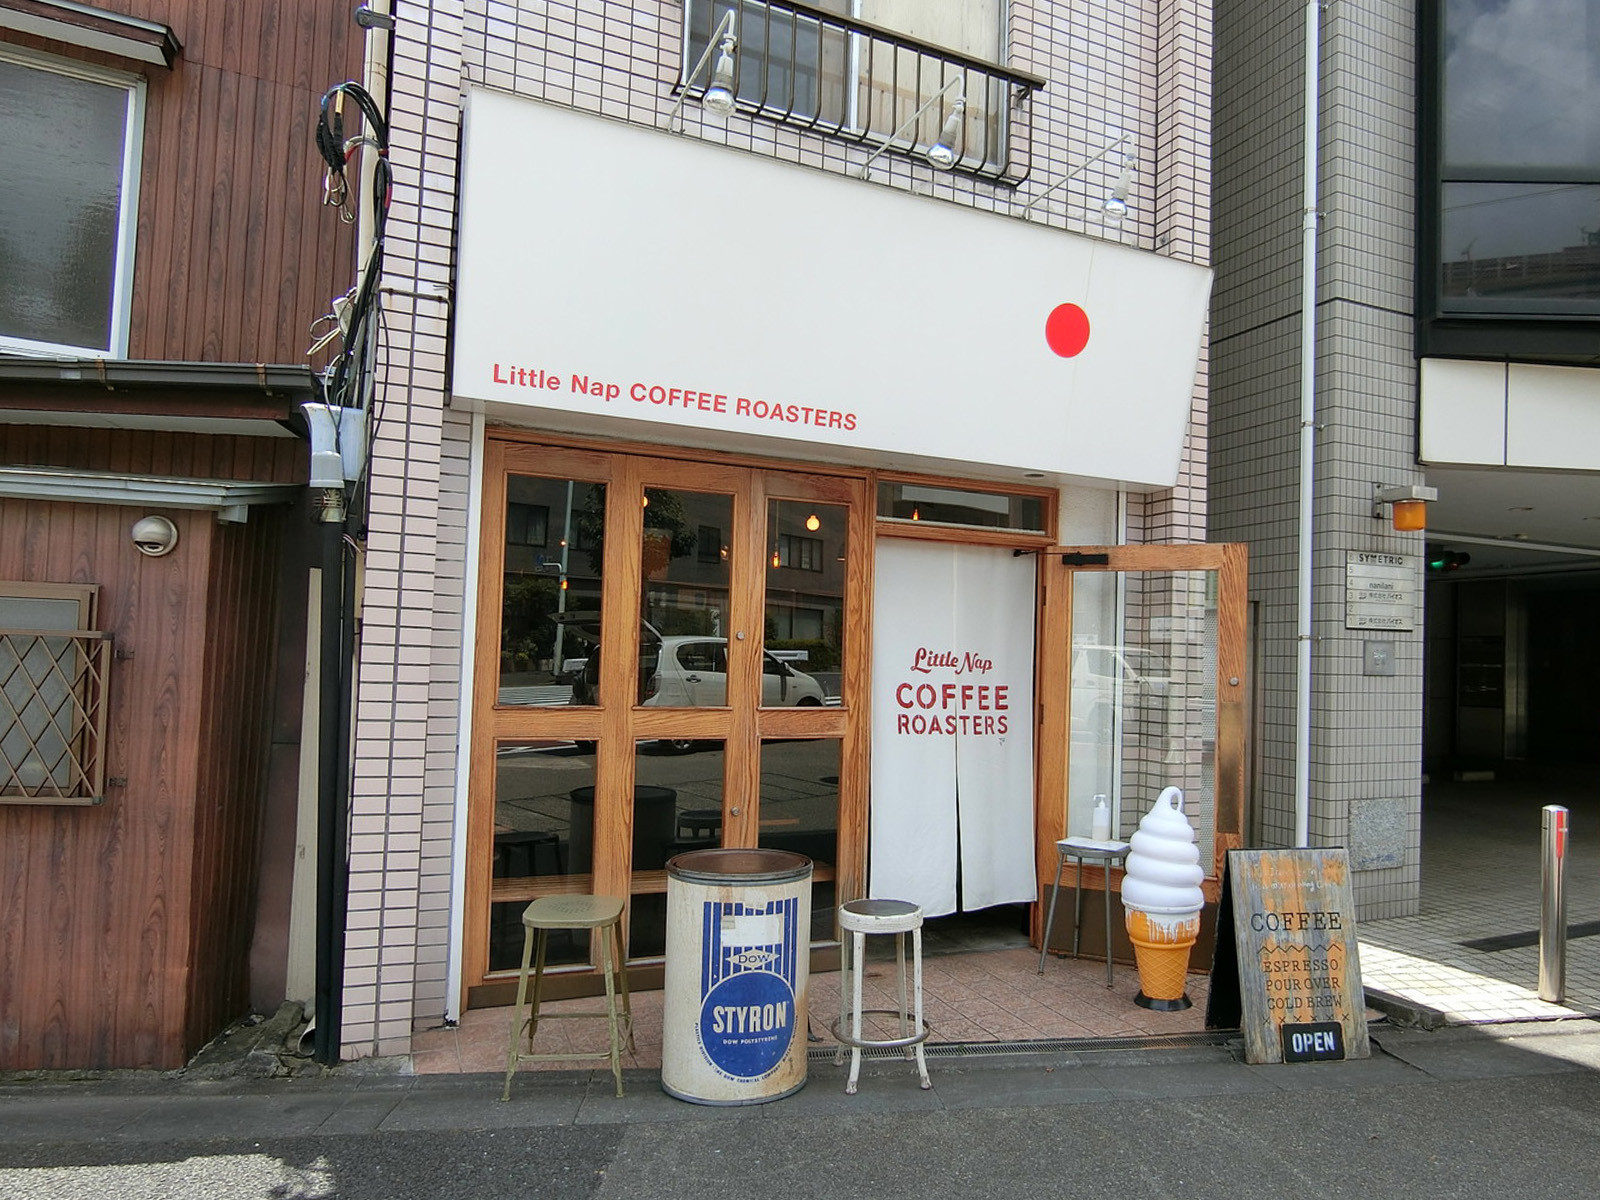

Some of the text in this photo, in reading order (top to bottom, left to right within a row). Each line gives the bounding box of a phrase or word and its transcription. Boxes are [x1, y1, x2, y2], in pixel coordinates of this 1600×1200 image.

[493, 363, 857, 432] Little Nap COFFEE ROASTERS
[1359, 554, 1403, 565] SYMETRIC
[910, 647, 993, 675] Little Nap
[895, 682, 1009, 711] COFFEE
[897, 714, 1008, 735] ROASTERS
[1250, 912, 1342, 932] COFFEE
[738, 955, 770, 964] DOW
[1263, 959, 1339, 973] ESPRESSO
[1266, 976, 1341, 991] POUR OVER
[1267, 994, 1342, 1010] COLD BREW
[712, 1001, 787, 1034] STYRON
[1292, 1031, 1335, 1053] OPEN
